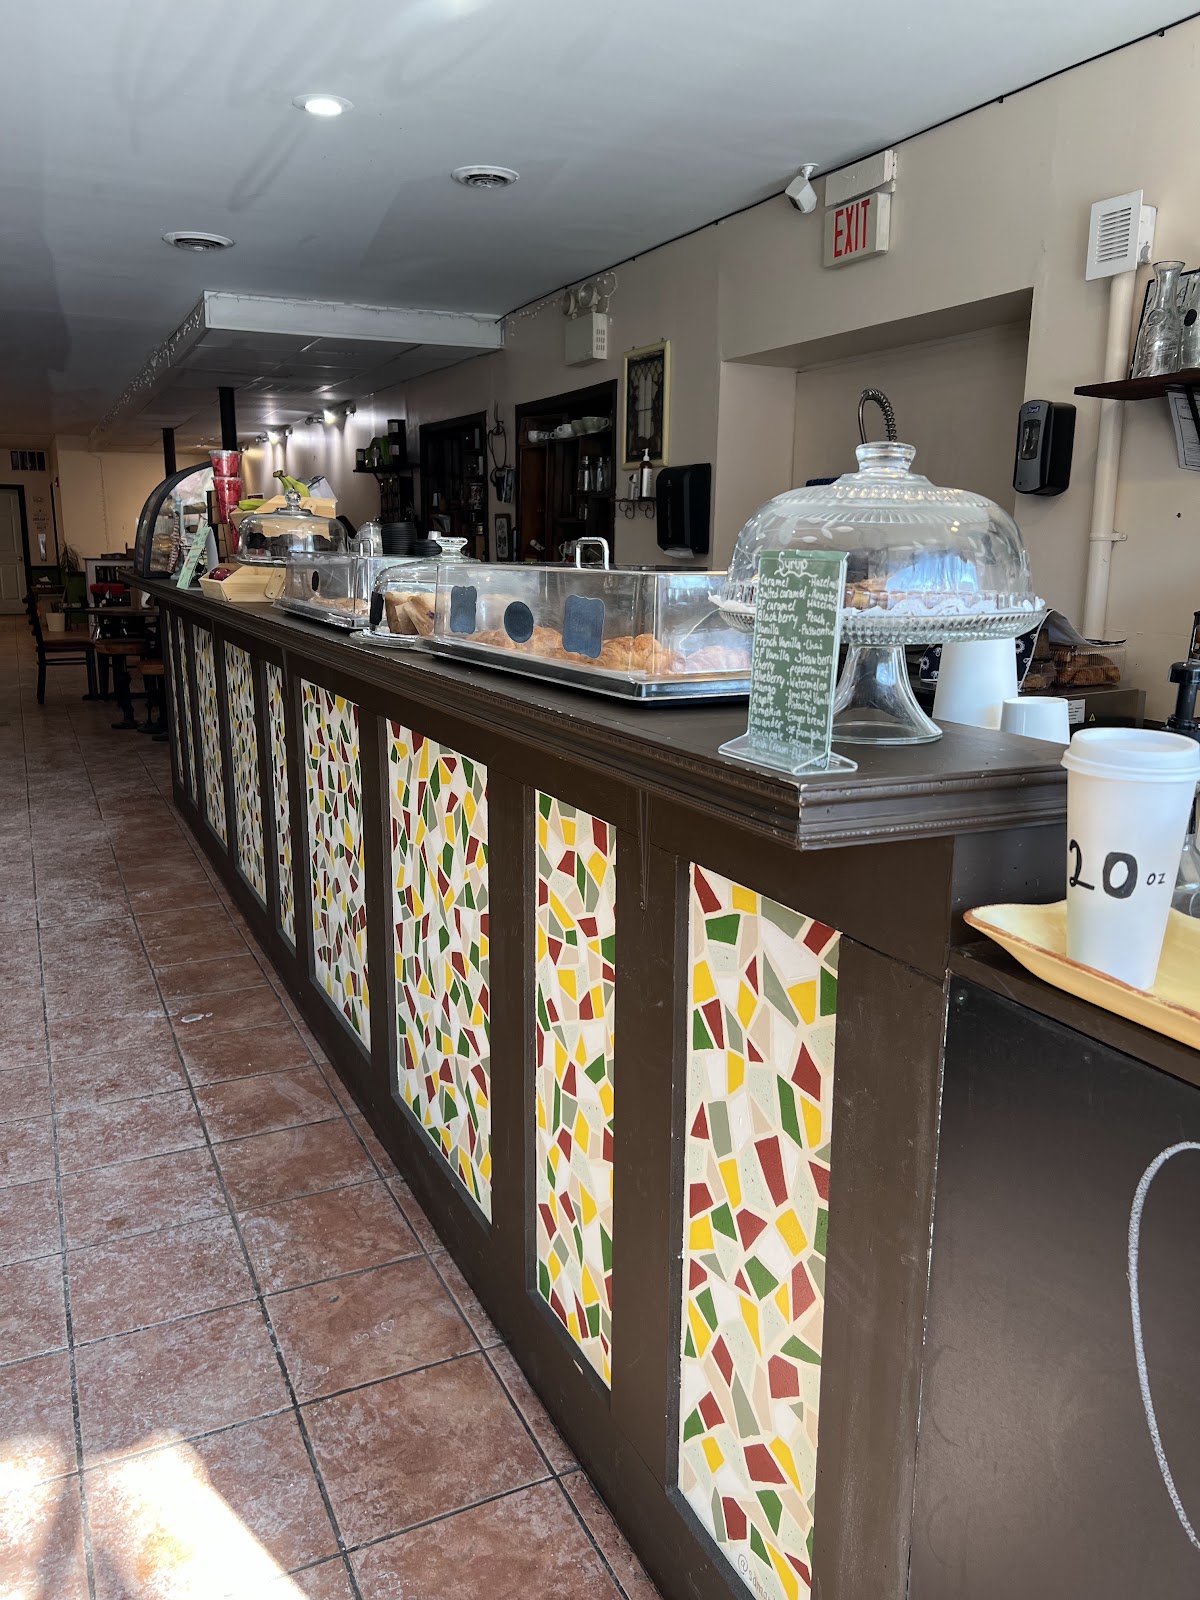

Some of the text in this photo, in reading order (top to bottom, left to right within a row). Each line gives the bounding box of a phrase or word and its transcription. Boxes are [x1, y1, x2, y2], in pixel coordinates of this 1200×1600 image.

[833, 198, 870, 258] EXIT
[778, 551, 809, 575] Syrup
[760, 574, 790, 588] Caramel
[759, 586, 807, 600] Salted caramel
[767, 599, 797, 612] caramel
[807, 610, 826, 626] Peach
[757, 621, 780, 636] Vanilla
[756, 634, 802, 651] French Vanilla
[805, 638, 823, 651] Chai
[765, 648, 790, 662] Vanilla
[754, 658, 776, 675] Cherry
[753, 669, 786, 689] Blueberry
[753, 681, 777, 696] Mango
[1069, 838, 1138, 899] 20
